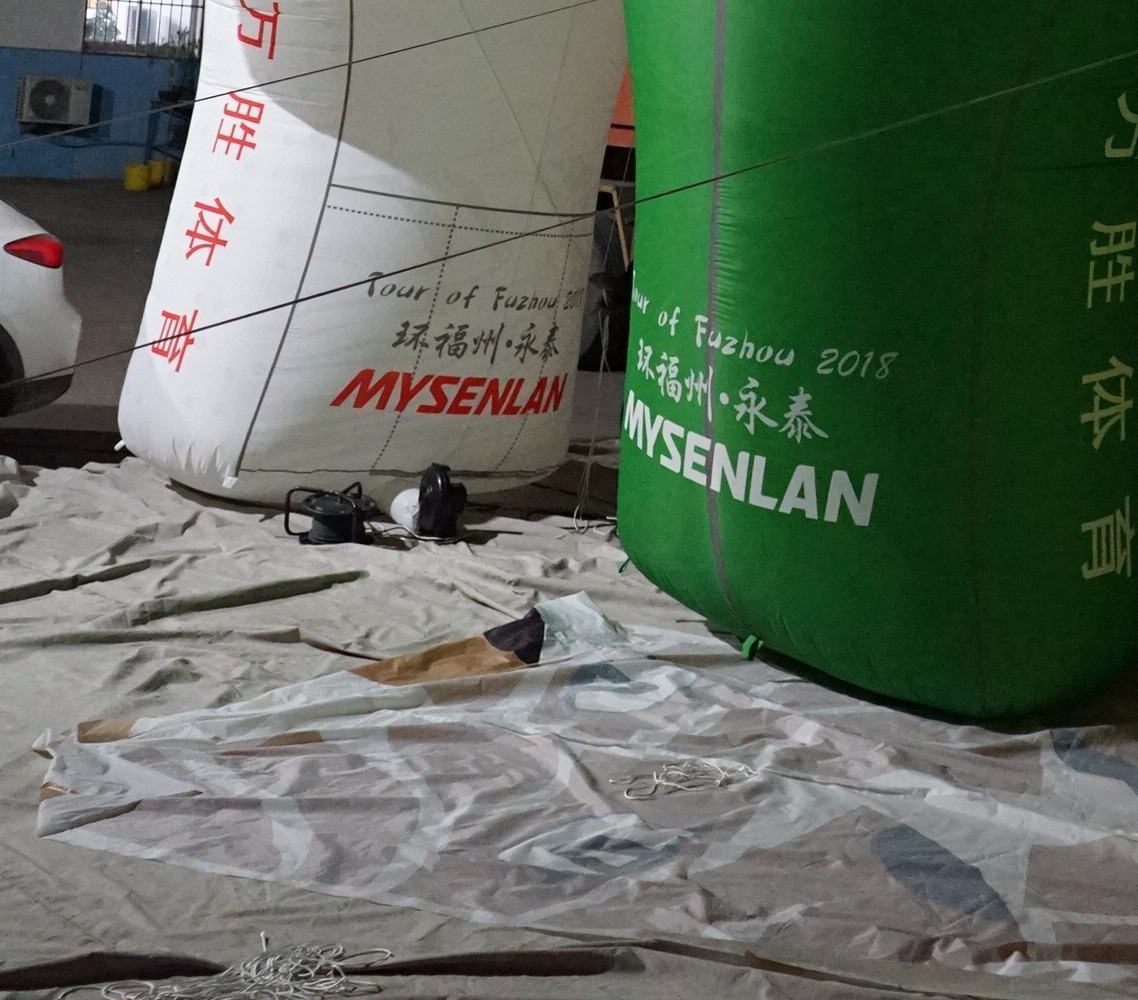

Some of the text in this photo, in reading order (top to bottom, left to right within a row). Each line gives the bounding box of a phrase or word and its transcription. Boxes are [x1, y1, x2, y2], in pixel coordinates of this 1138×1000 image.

[366, 271, 430, 301] Tour
[446, 284, 480, 309] of
[492, 286, 556, 312] Fuzhou
[657, 306, 681, 337] of
[694, 314, 796, 368] Fuzhou
[816, 348, 900, 380] 2018
[329, 367, 569, 417] MYSENLAN
[623, 388, 880, 528] MYSENLAN
